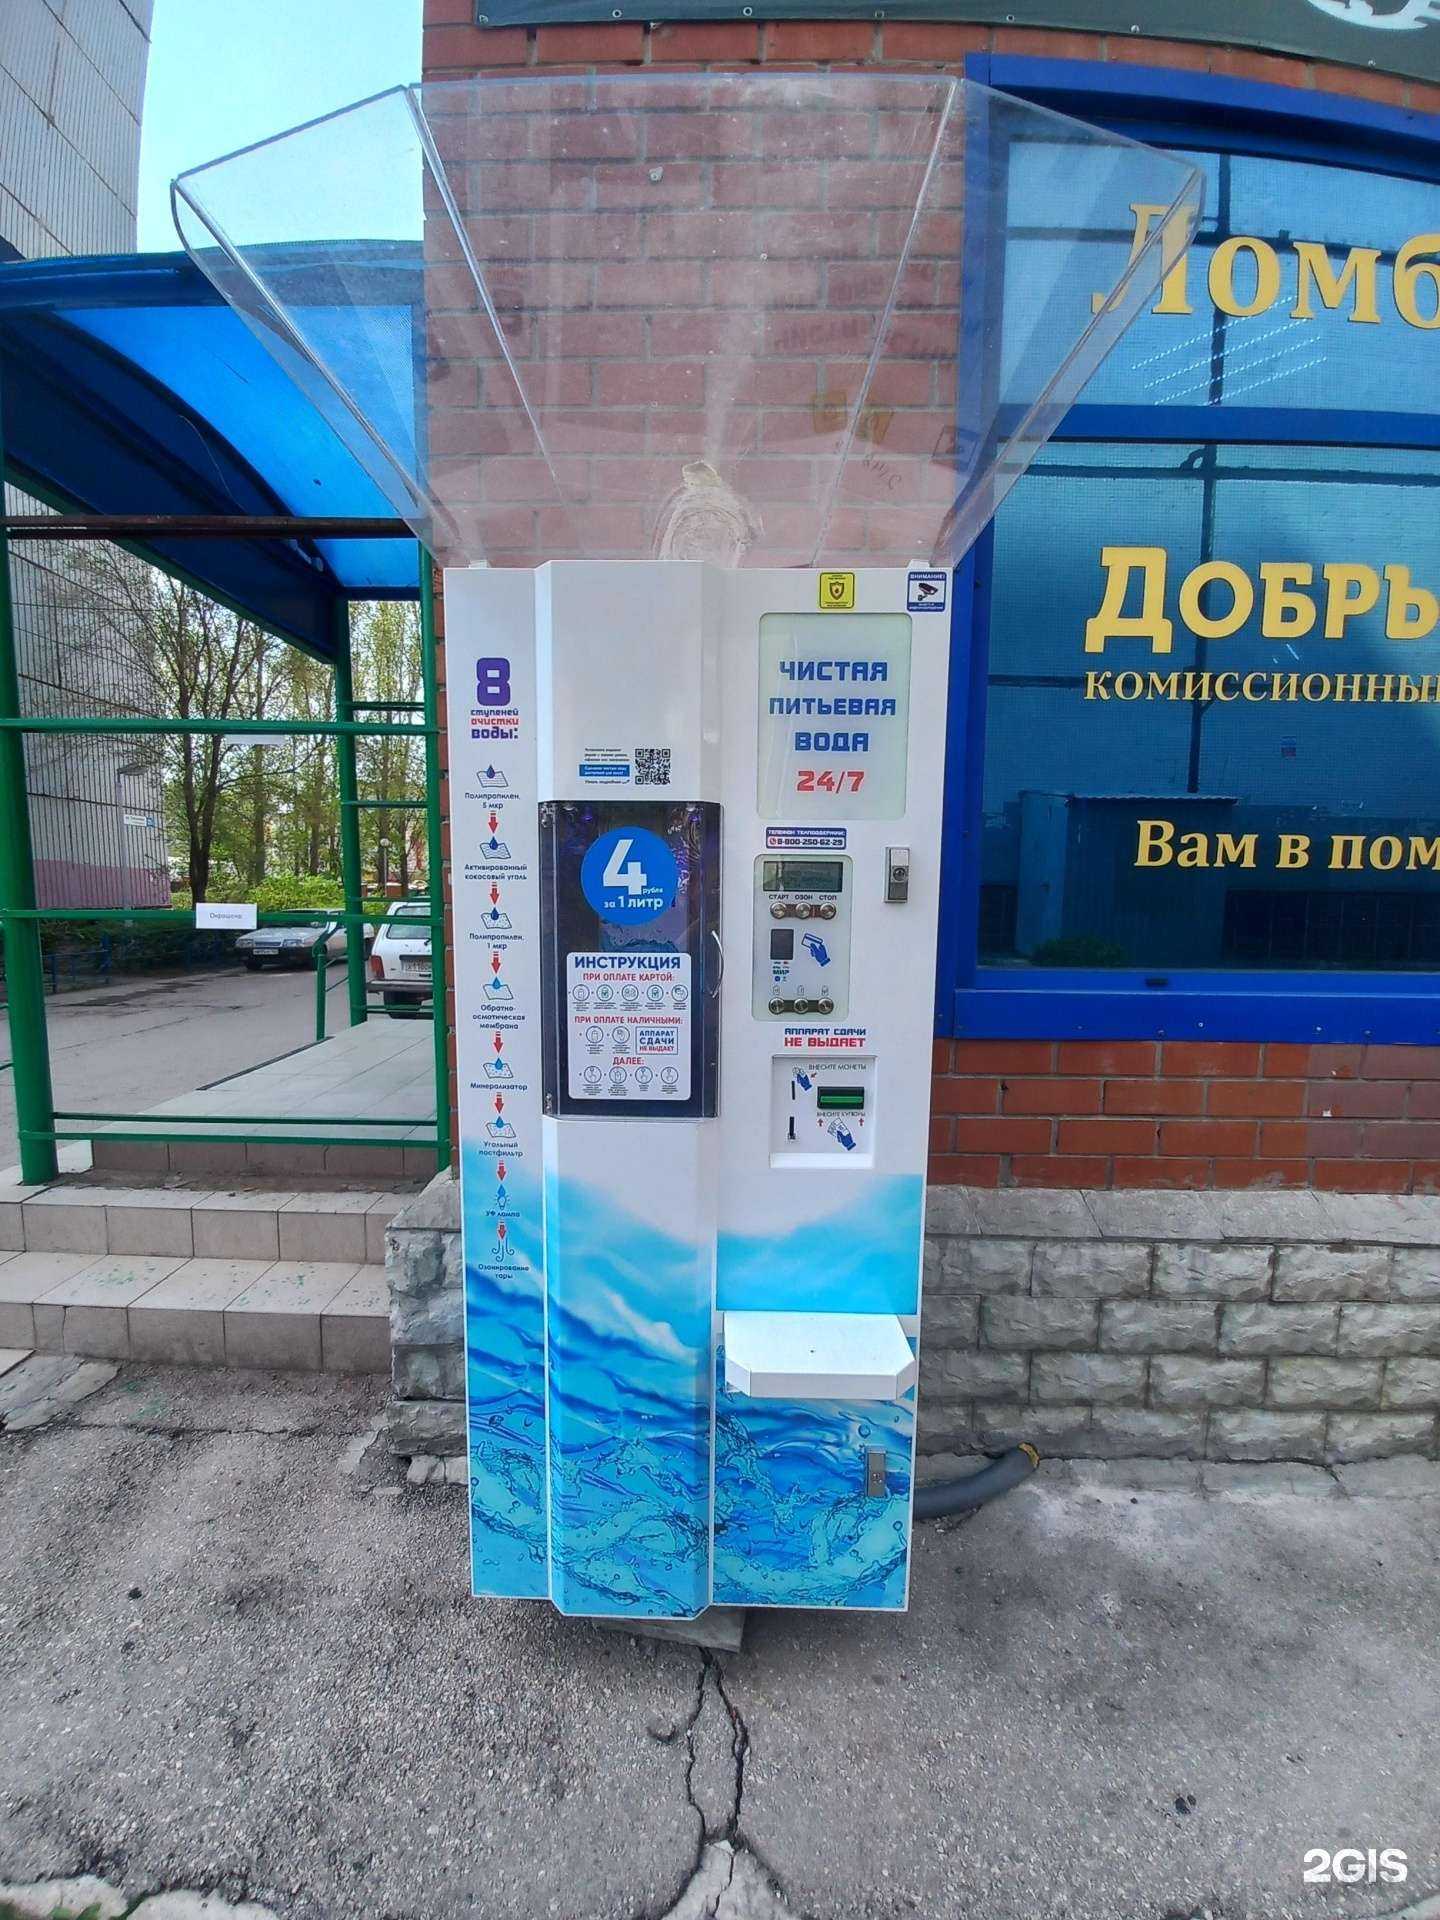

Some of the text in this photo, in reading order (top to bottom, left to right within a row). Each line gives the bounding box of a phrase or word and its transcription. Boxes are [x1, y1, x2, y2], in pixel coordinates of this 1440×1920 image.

[1091, 203, 1440, 330] Ломб
[779, 661, 888, 682] ЧИСТАЯ
[476, 657, 511, 706] 8
[769, 697, 896, 716] ПИТЬЕВАЯ
[470, 708, 519, 717] ступеней
[471, 717, 519, 726] очистки
[471, 726, 519, 739] воды:
[794, 732, 869, 752] ВОДА
[796, 770, 865, 794] 24/7
[488, 803, 504, 811] мкр
[1133, 819, 1440, 871] Вам в пом
[464, 864, 528, 872] Активированный
[603, 838, 648, 896] 4
[464, 873, 527, 882] кокосовый уголь
[603, 895, 664, 911] за 1 литр
[574, 956, 681, 971] ИНСТРУКЦИЯ
[583, 973, 601, 981] ПРИ
[603, 973, 636, 981] ОПЛАТЕ
[574, 1016, 592, 1024] ПРИ
[593, 1016, 625, 1024] ОПЛАТЕ
[480, 1022, 519, 1032] мембрана
[784, 1028, 866, 1036] АППАРАТ СДАЧИ
[639, 1037, 675, 1045] СДАЧИ
[784, 1037, 866, 1048] НЕ ВЫДАЕТ
[612, 1057, 645, 1066] ДАЛЕЕ:
[470, 1082, 528, 1092] Минерализатор
[483, 1141, 519, 1150] Угольный
[478, 1149, 524, 1158] постфильтр
[478, 1263, 530, 1272] Озонирование
